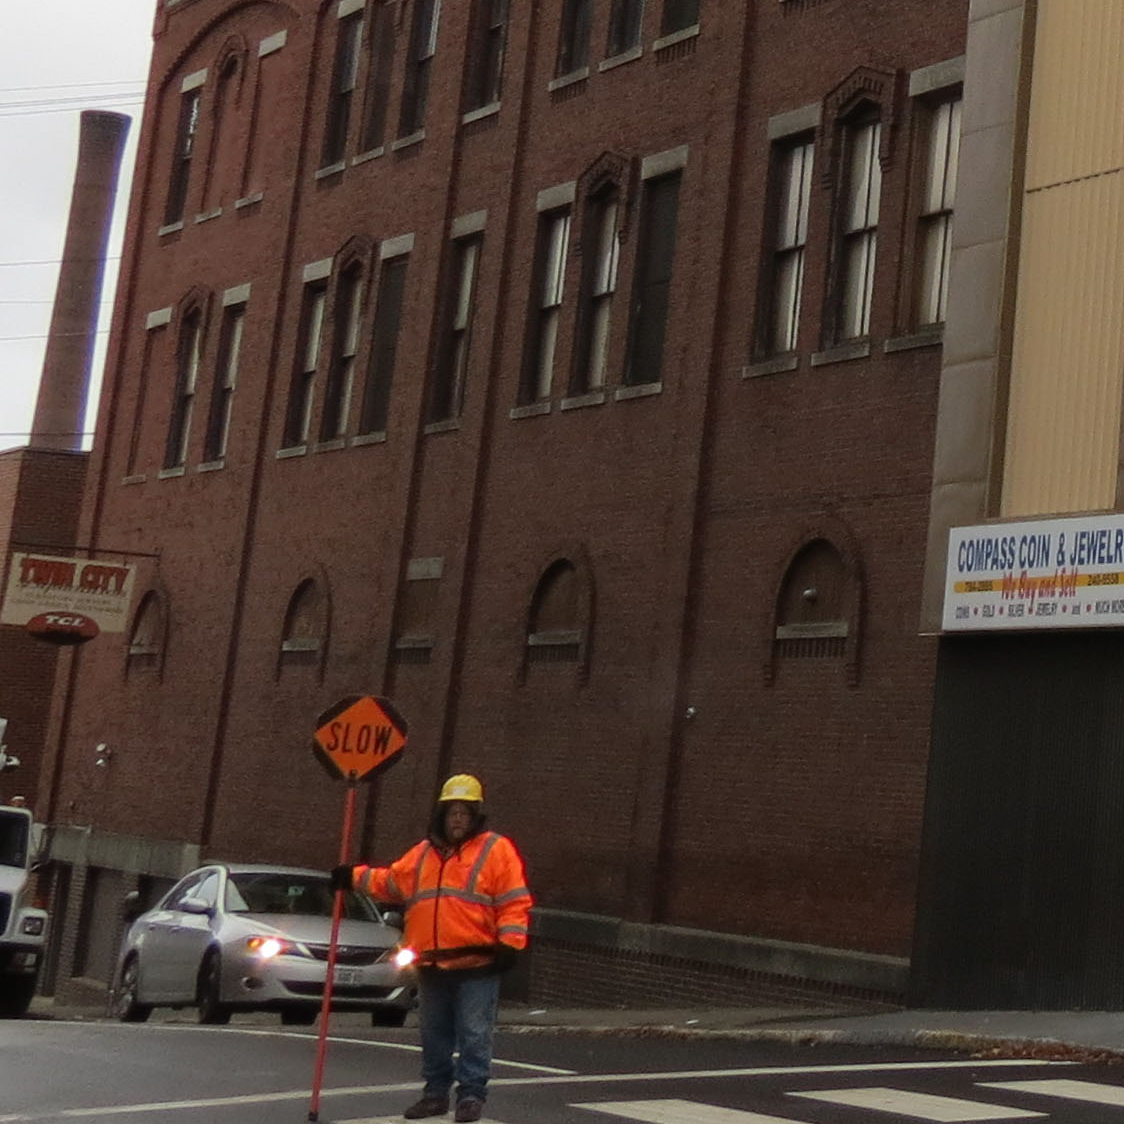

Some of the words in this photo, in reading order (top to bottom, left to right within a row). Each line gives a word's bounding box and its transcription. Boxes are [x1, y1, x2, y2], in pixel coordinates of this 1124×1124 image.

[958, 536, 1015, 572] COMPASS
[1019, 534, 1051, 568] COIN
[1056, 532, 1066, 566] &
[20, 558, 77, 587] TWIN
[80, 564, 131, 594] CITY
[1001, 571, 1017, 600] We
[1018, 570, 1038, 607] Buy
[1039, 568, 1058, 598] and
[1059, 566, 1078, 597] Sell
[327, 722, 393, 755] SLOW
